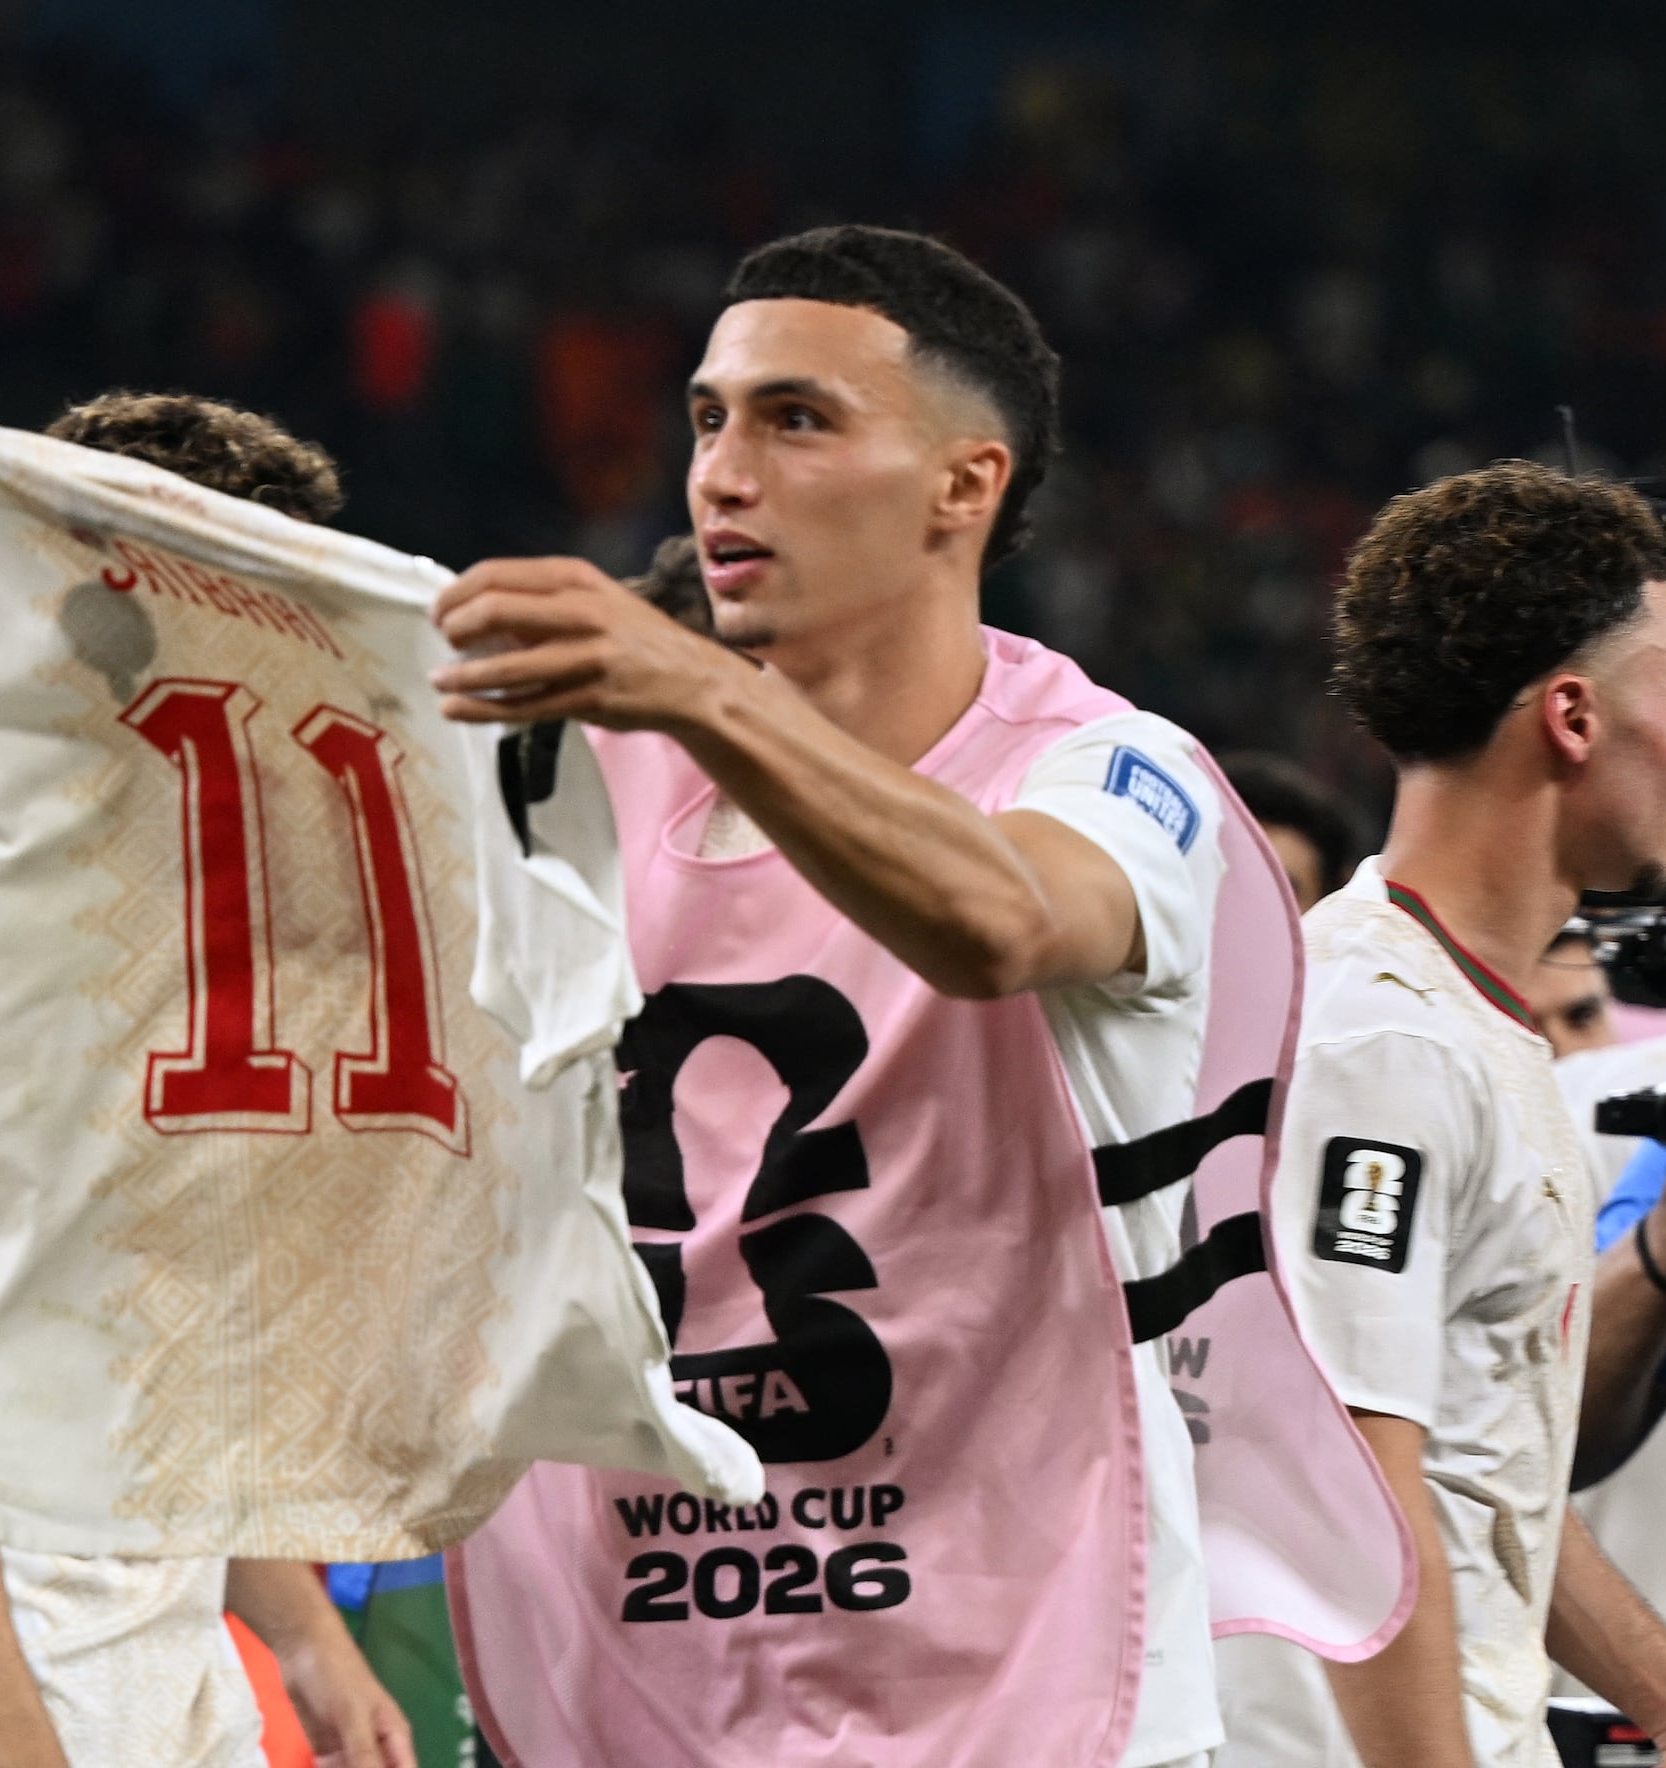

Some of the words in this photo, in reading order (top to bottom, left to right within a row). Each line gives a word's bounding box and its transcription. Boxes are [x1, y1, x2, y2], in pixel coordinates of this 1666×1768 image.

[118, 677, 472, 1159] 11
[614, 1487, 780, 1538] WORLD
[791, 1484, 906, 1530] CUP
[622, 1541, 912, 1623] 2026
